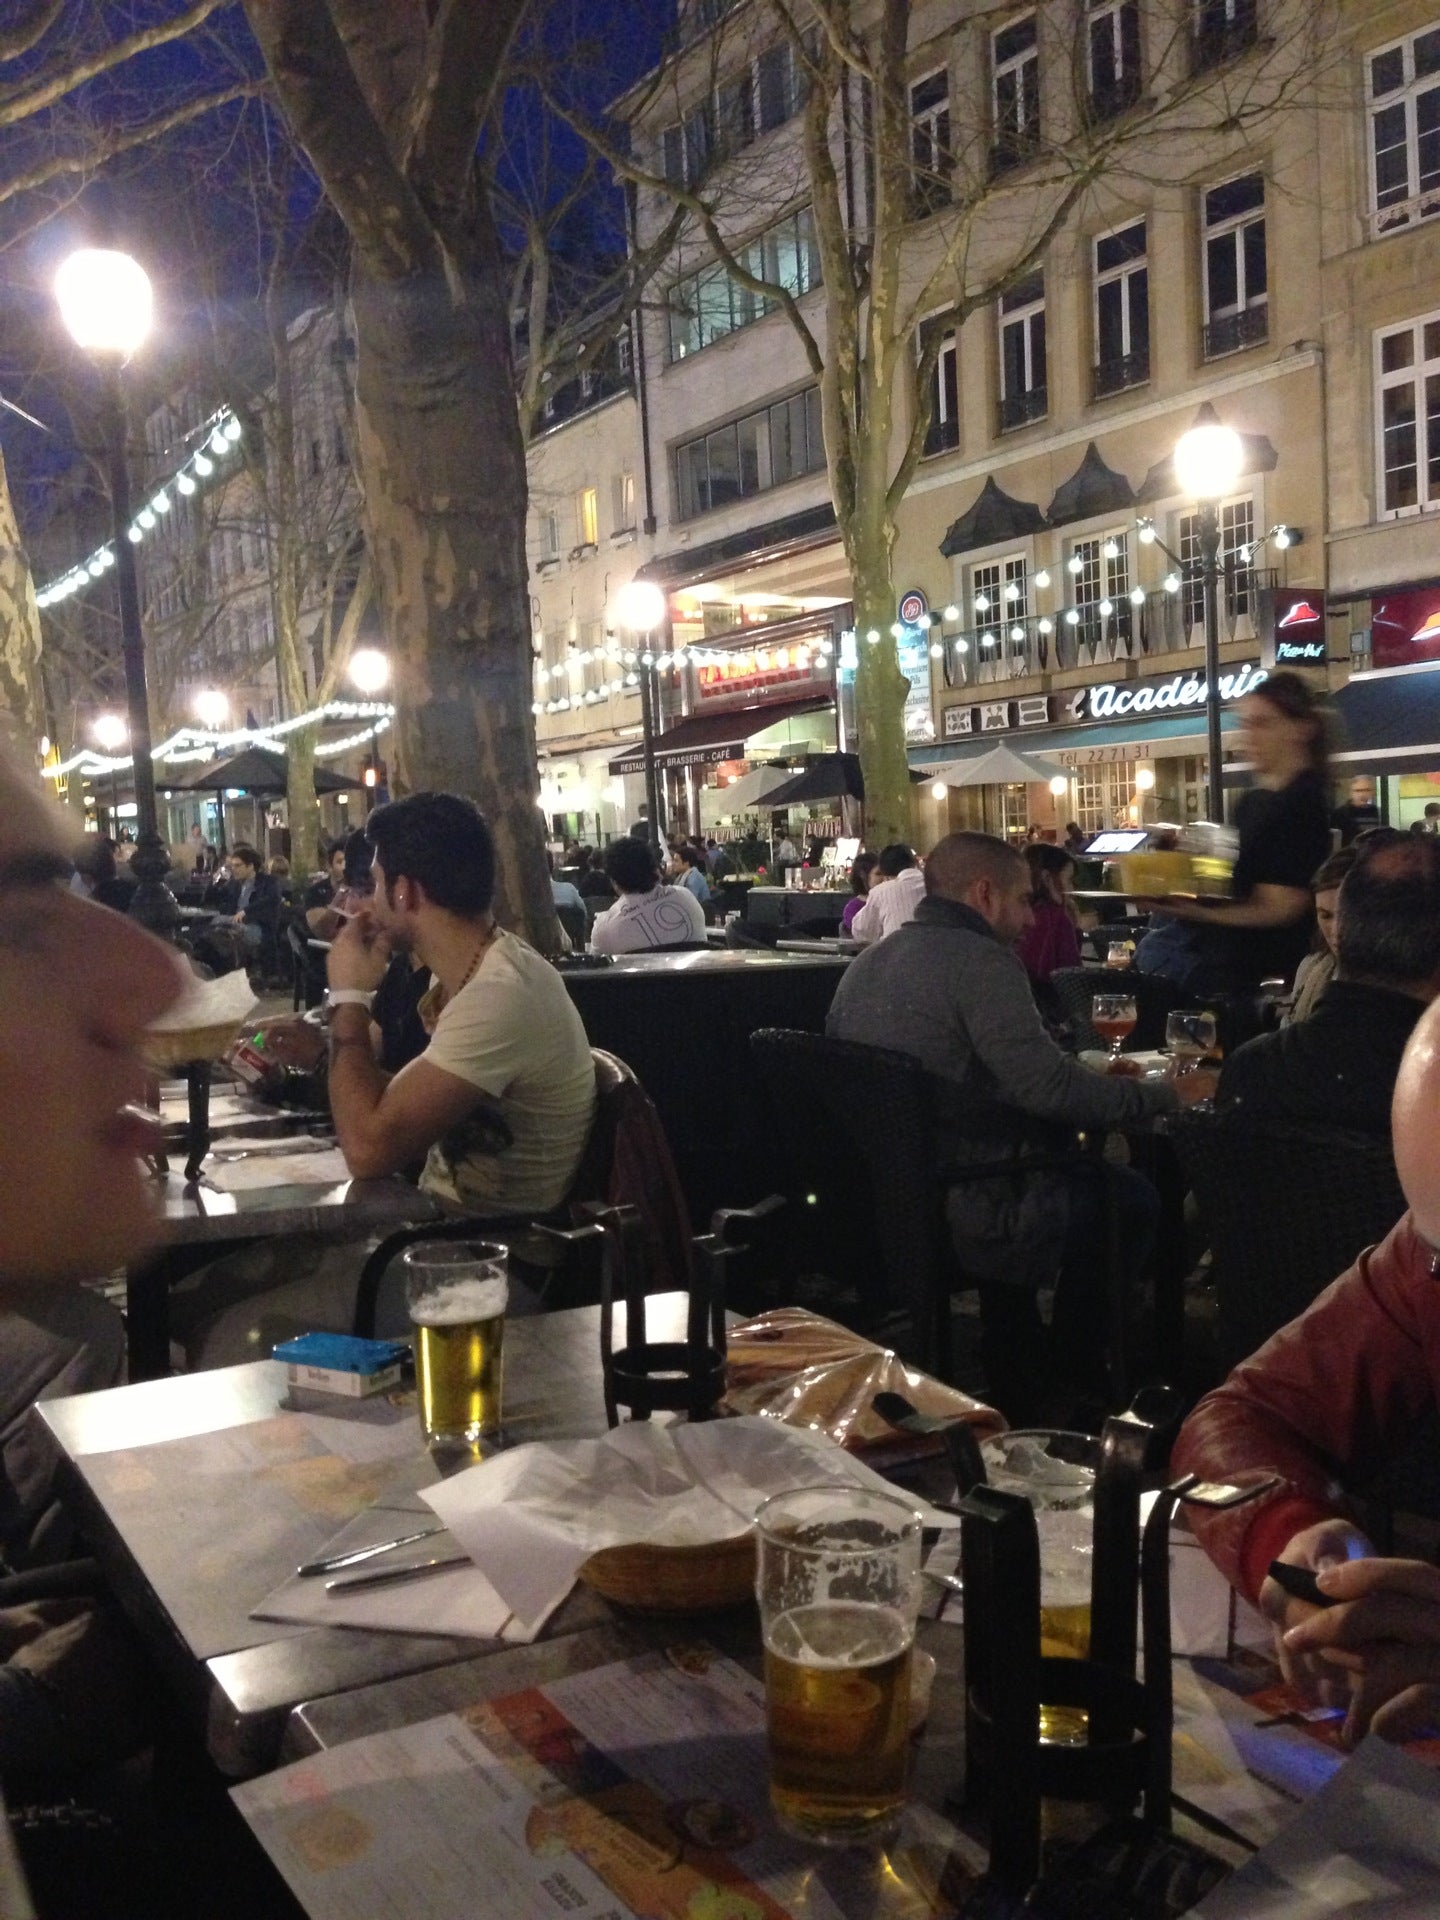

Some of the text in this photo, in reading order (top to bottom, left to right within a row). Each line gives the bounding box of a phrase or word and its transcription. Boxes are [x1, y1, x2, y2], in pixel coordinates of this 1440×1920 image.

[667, 753, 705, 767] BRASSERIE
[711, 748, 731, 761] CAFÉ
[1088, 750, 1104, 761] 22
[1111, 748, 1126, 760] 71
[1135, 745, 1150, 759] 31
